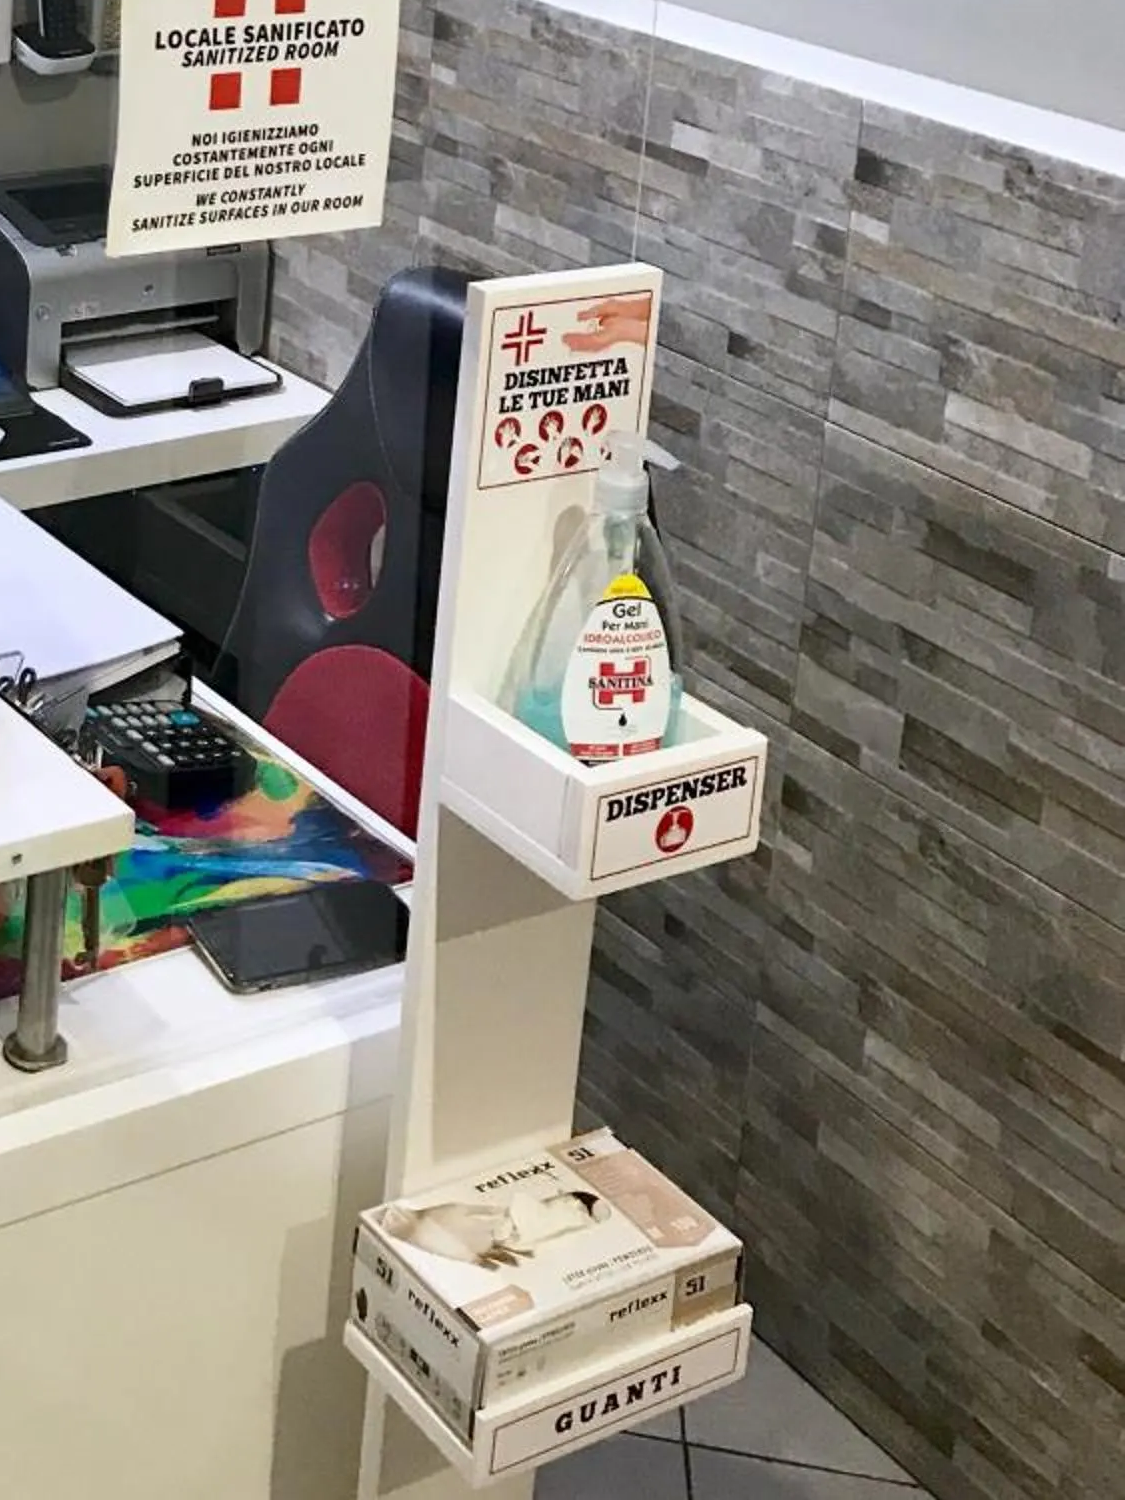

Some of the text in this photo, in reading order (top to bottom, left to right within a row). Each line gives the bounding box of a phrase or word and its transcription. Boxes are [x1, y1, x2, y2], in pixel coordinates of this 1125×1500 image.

[154, 17, 365, 51] LOCALE SANIFICATO
[181, 40, 340, 68] SANITIZED ROOM
[191, 123, 319, 147] NOI IGIENIZZIAMO
[172, 139, 334, 167] COSTANTEMENTE OGNI
[133, 153, 366, 189] SUPERFICIE DEL NOSTRO LOCALE
[195, 183, 307, 207] WE CONSTANTLY
[131, 194, 364, 233] SANITIZE SURFACES IN OUR ROOM
[503, 357, 629, 391] DISINFETTA
[498, 378, 630, 415] LE TUE MANI
[612, 602, 642, 619] Gel
[605, 765, 748, 822] DISPENSER
[474, 1160, 557, 1194] reflexx
[407, 1288, 460, 1349] reflexx
[608, 1289, 669, 1323] reflexx
[554, 1365, 684, 1435] GUANTI
